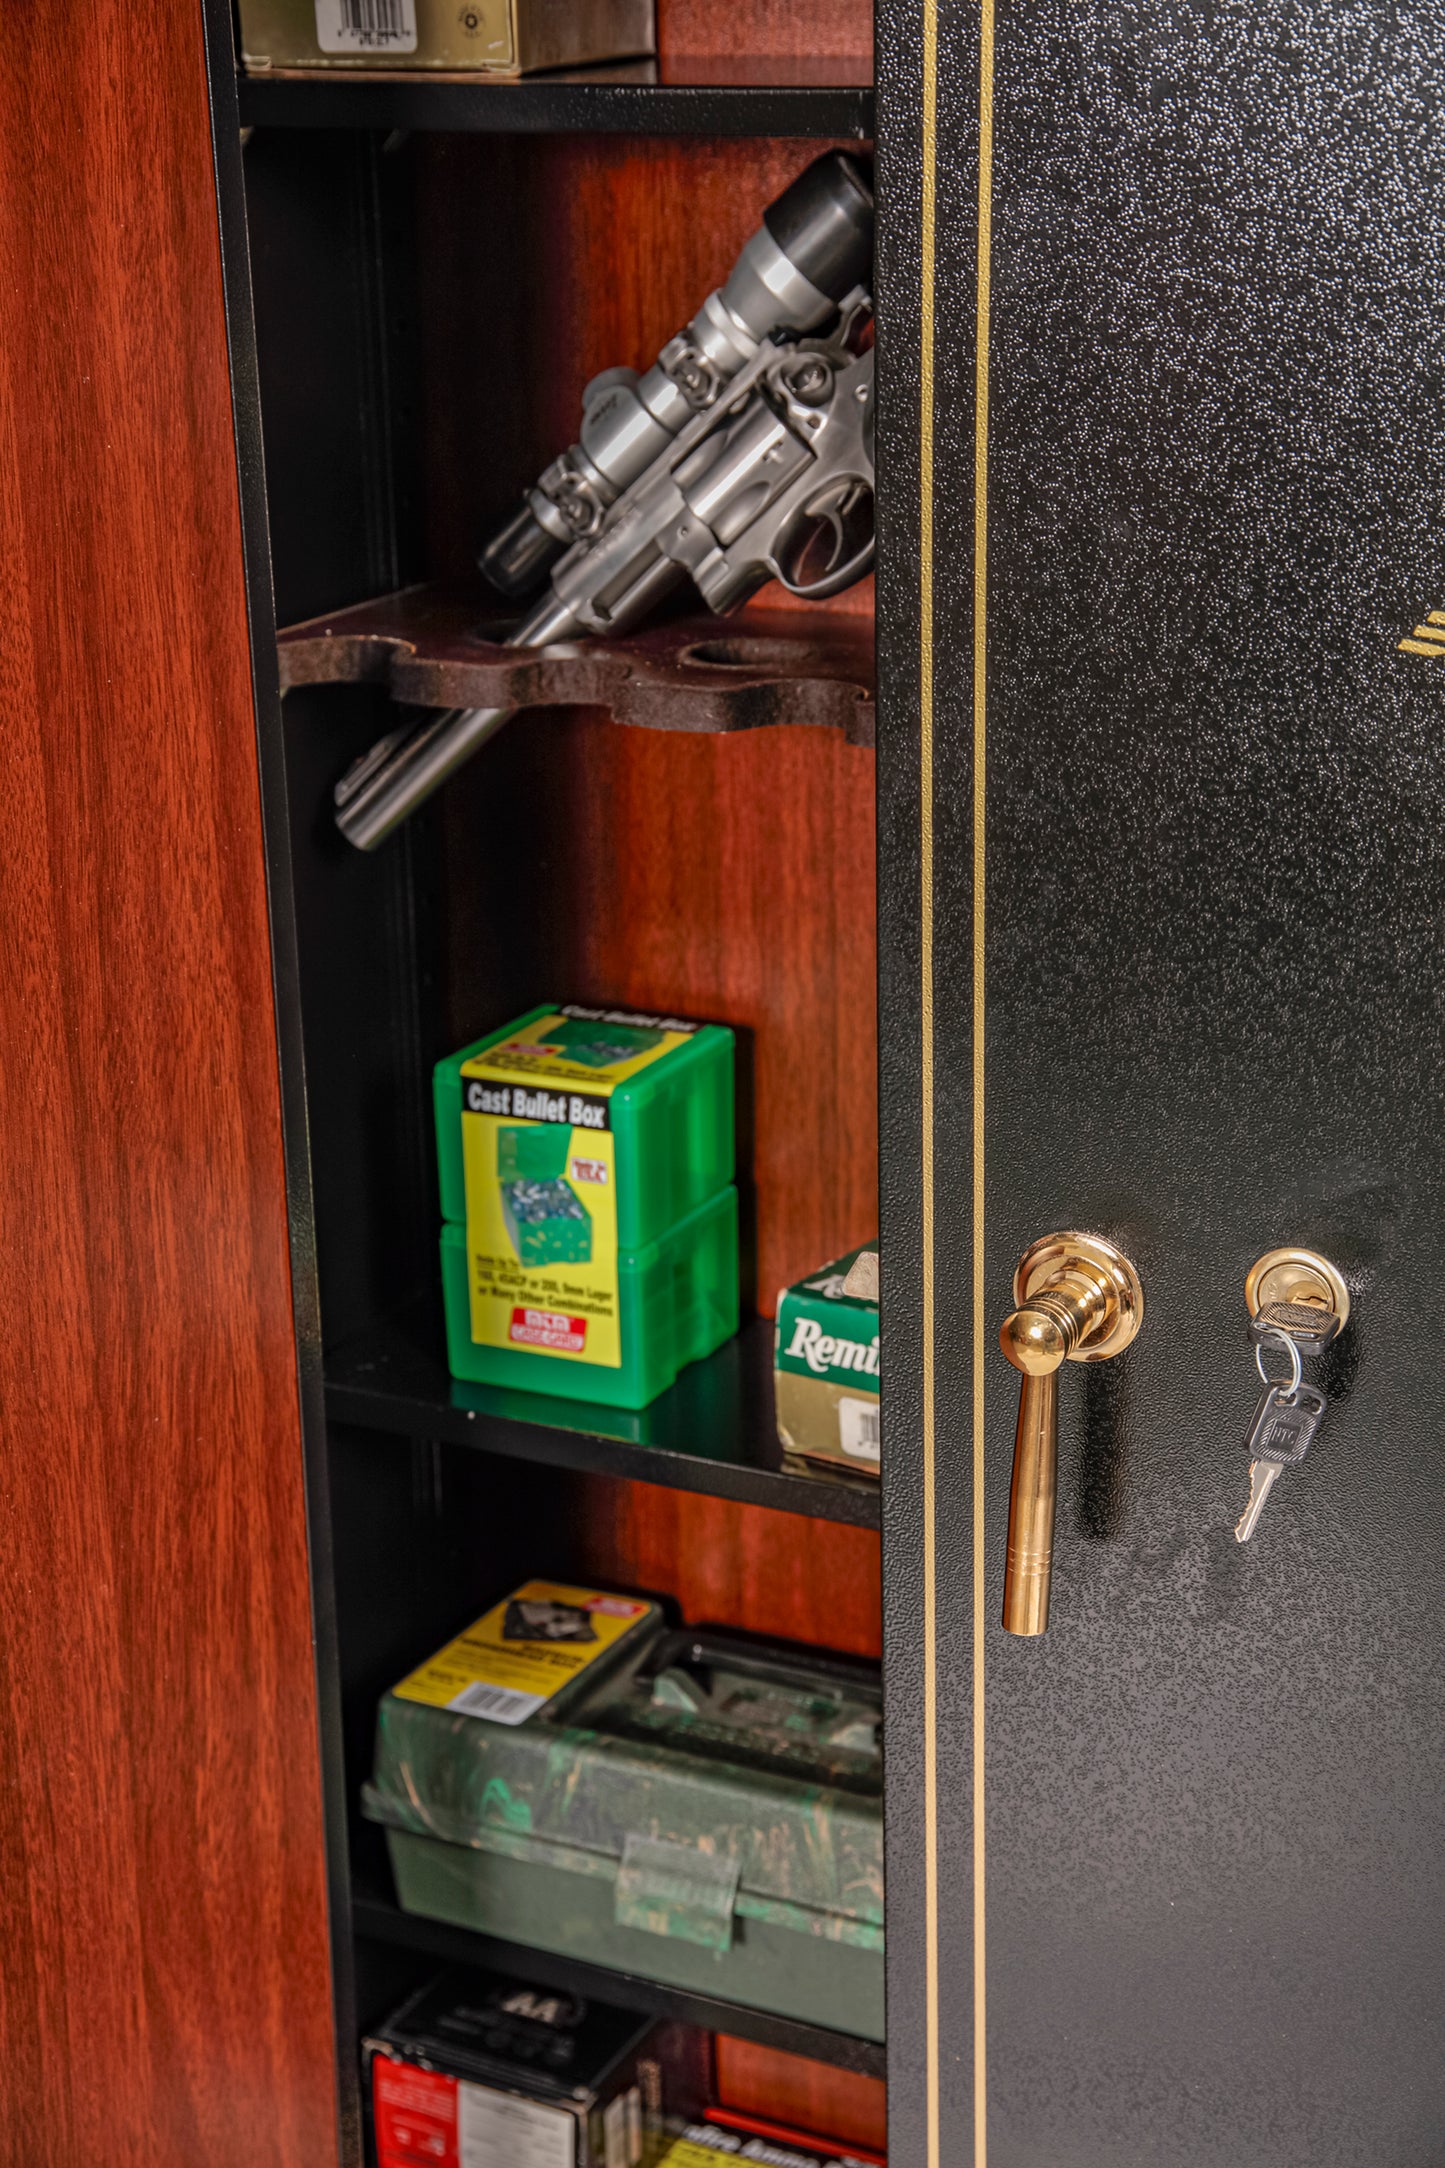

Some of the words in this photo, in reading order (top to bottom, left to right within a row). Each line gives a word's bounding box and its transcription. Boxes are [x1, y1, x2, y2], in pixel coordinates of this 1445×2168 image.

[468, 1083, 510, 1114] Cast
[512, 1089, 566, 1123] Bullet
[569, 1097, 606, 1128] Box
